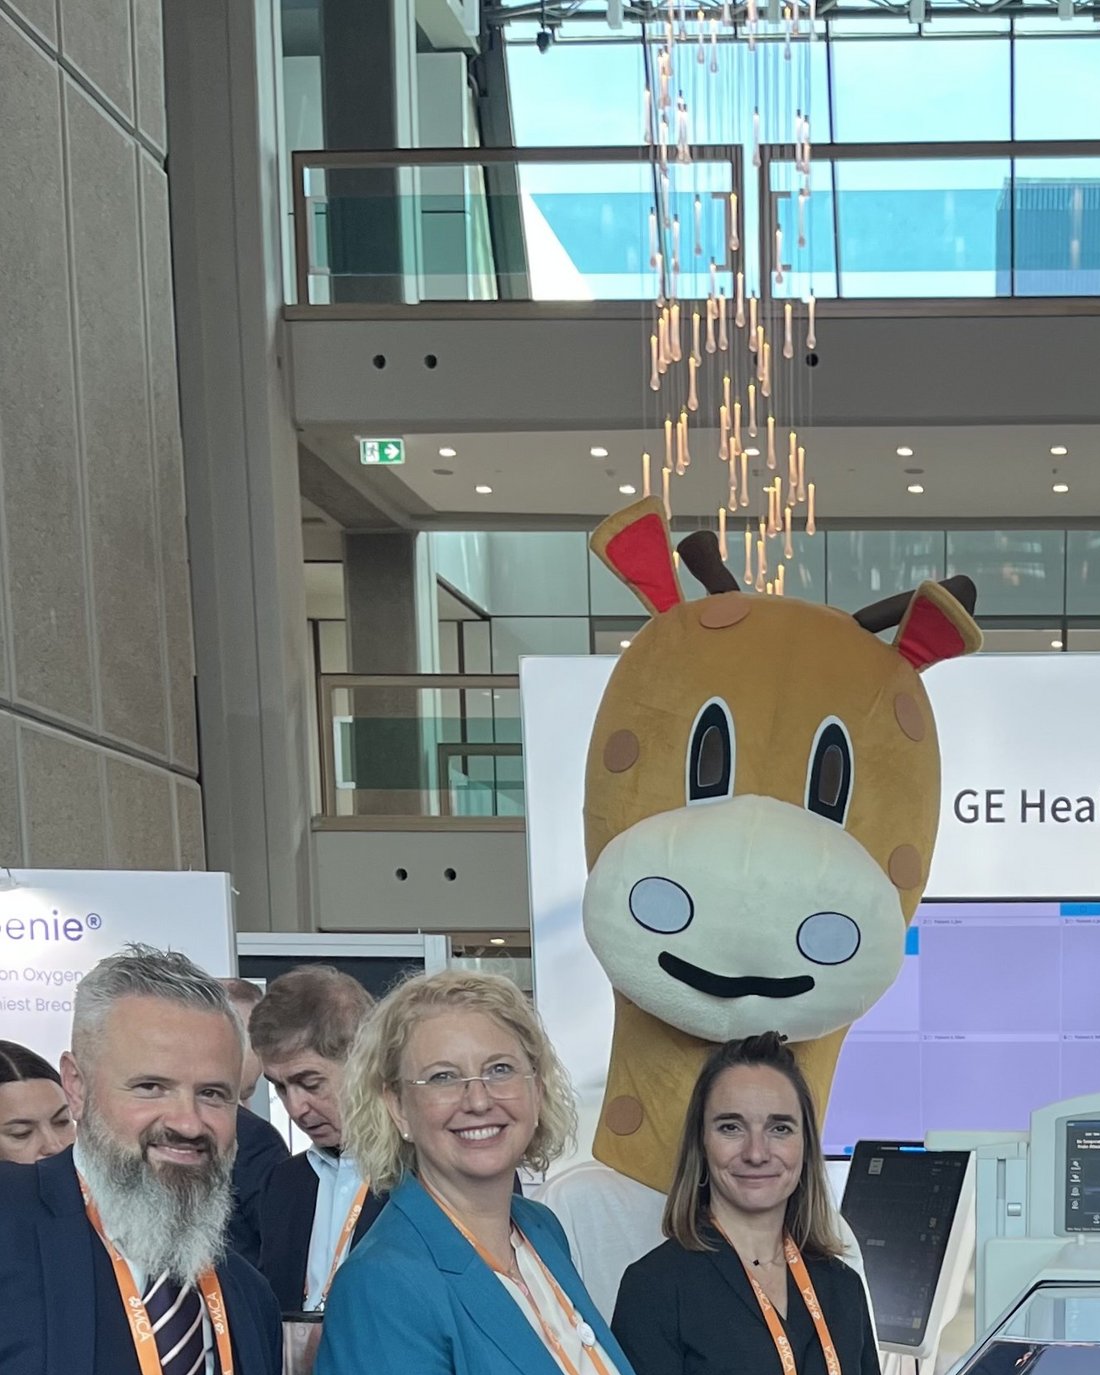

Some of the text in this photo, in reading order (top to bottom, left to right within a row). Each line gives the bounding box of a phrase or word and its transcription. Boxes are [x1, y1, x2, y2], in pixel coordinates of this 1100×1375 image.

[953, 788, 1006, 824] GE
[23, 967, 84, 986] Oxygen
[0, 996, 31, 1012] iest
[207, 1291, 223, 1322] MCA
[132, 1308, 152, 1341] MCA
[781, 1345, 795, 1372] MCA
